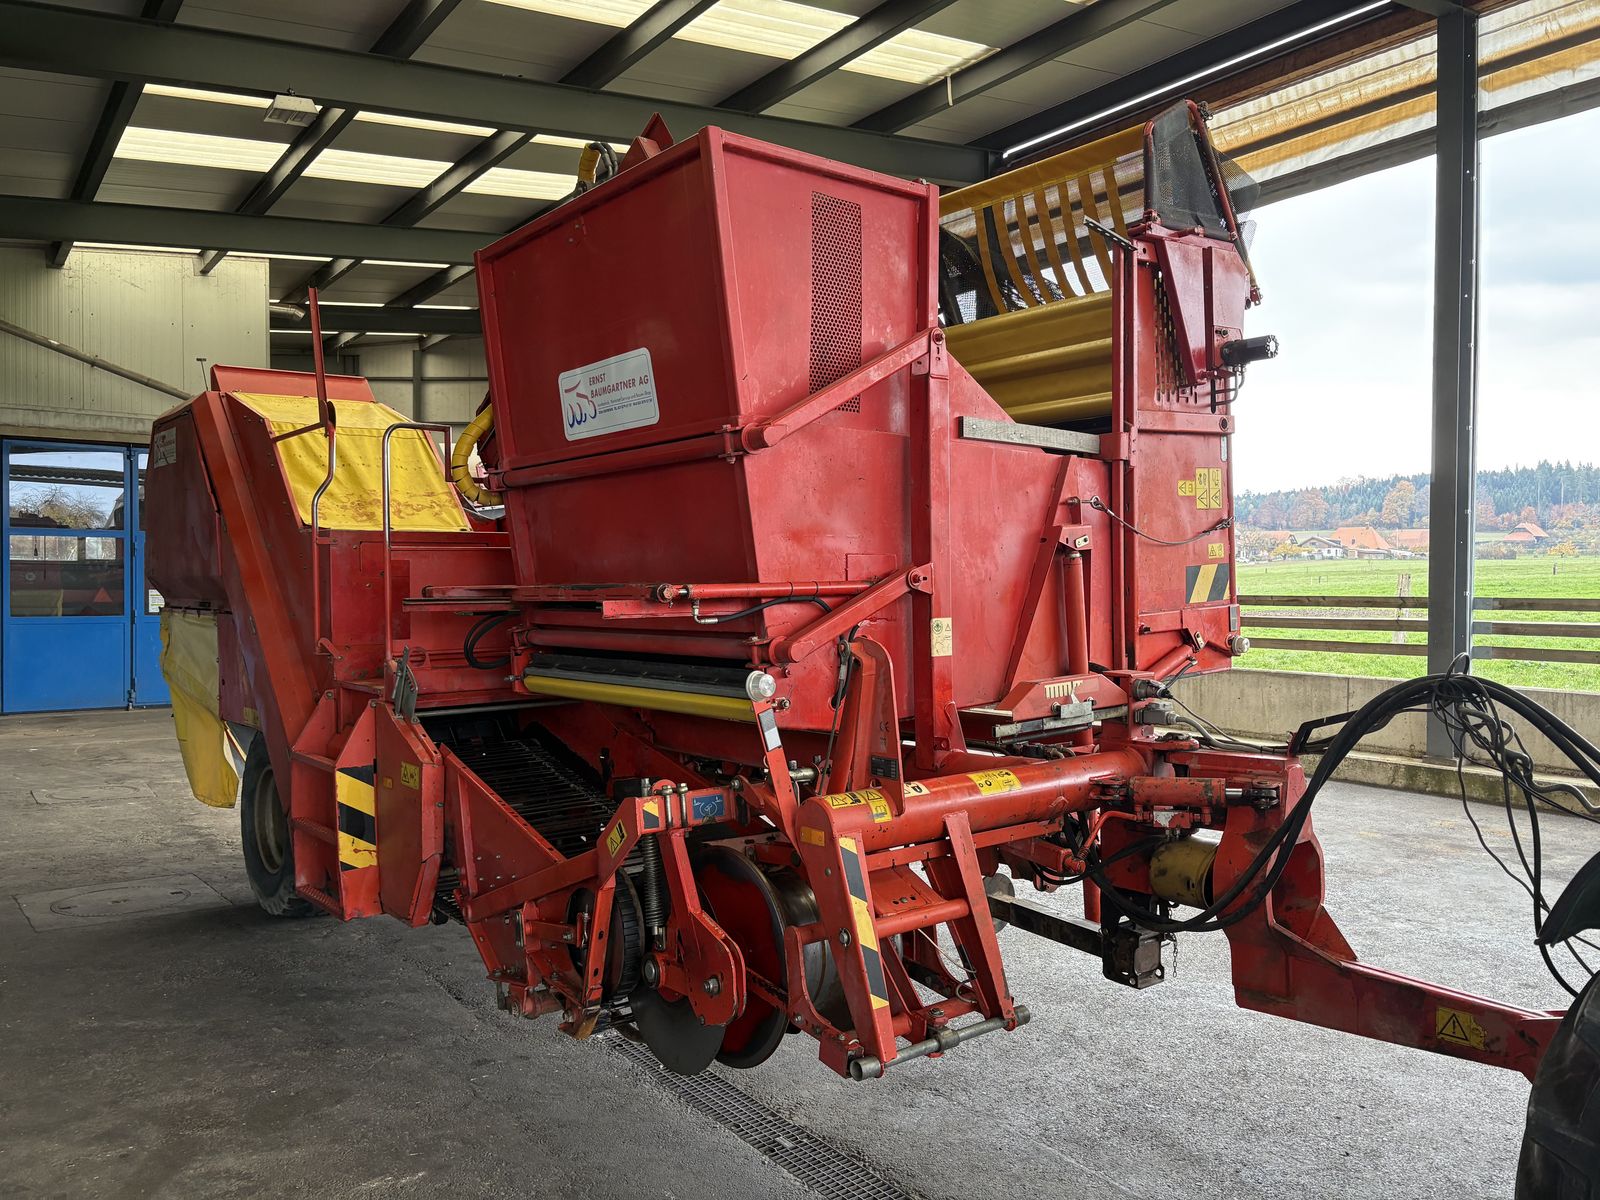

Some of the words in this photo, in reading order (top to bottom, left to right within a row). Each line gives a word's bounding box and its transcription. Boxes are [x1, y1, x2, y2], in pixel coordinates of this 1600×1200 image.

[589, 373, 606, 386] ERNST
[590, 378, 636, 398] BAUMGARTNER
[638, 375, 649, 386] AG
